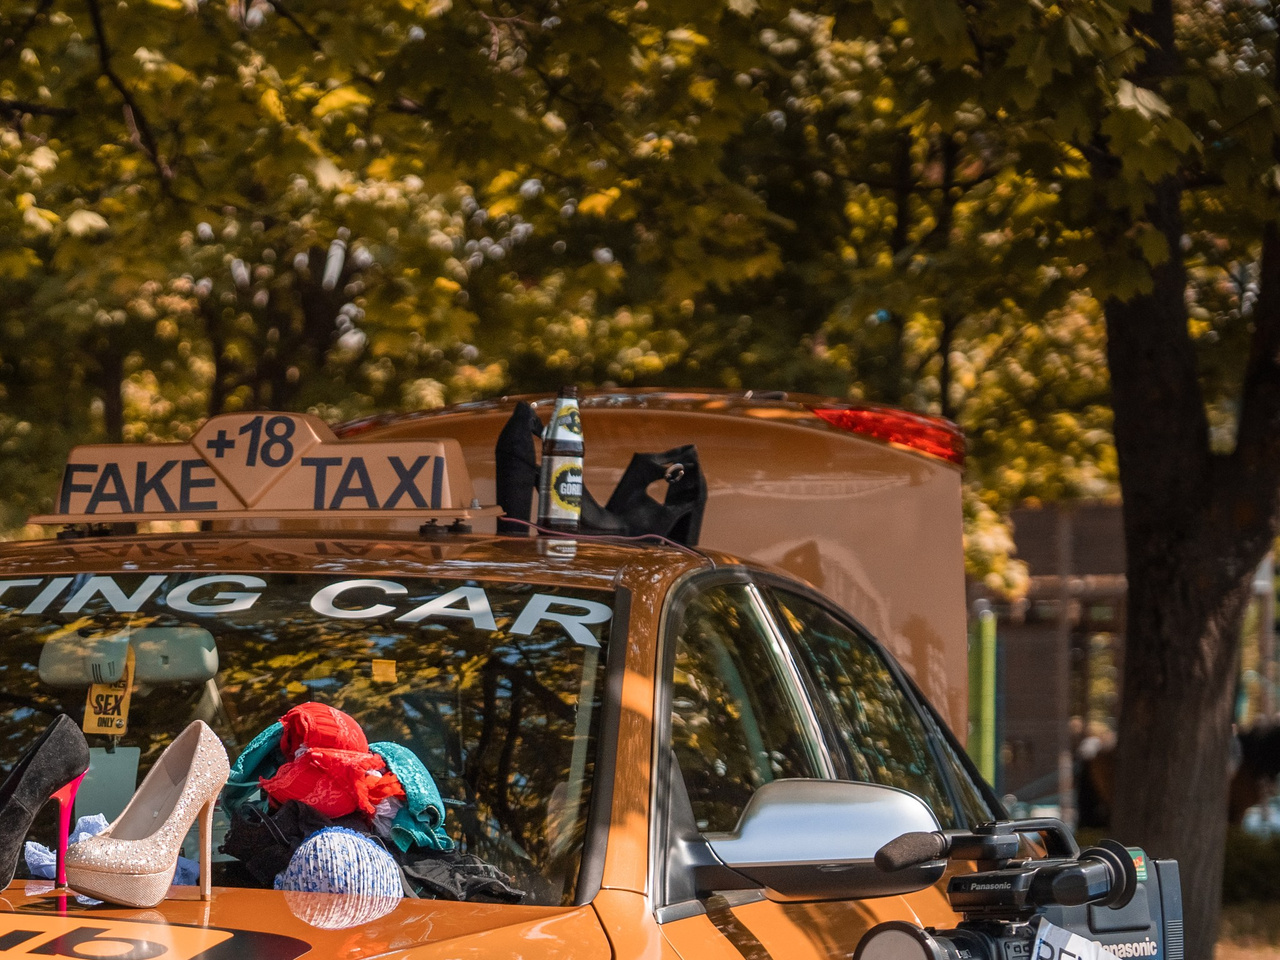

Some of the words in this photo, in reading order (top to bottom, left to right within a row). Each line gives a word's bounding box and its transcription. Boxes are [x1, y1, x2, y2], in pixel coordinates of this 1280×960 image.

[206, 416, 296, 467] +18
[59, 459, 218, 514] FAKE
[301, 455, 445, 510] TAXI
[310, 579, 613, 648] CAR
[93, 694, 124, 716] SEX
[97, 717, 115, 728] ONLY
[970, 881, 1012, 892] Panasonic
[1091, 936, 1158, 959] anasonic
